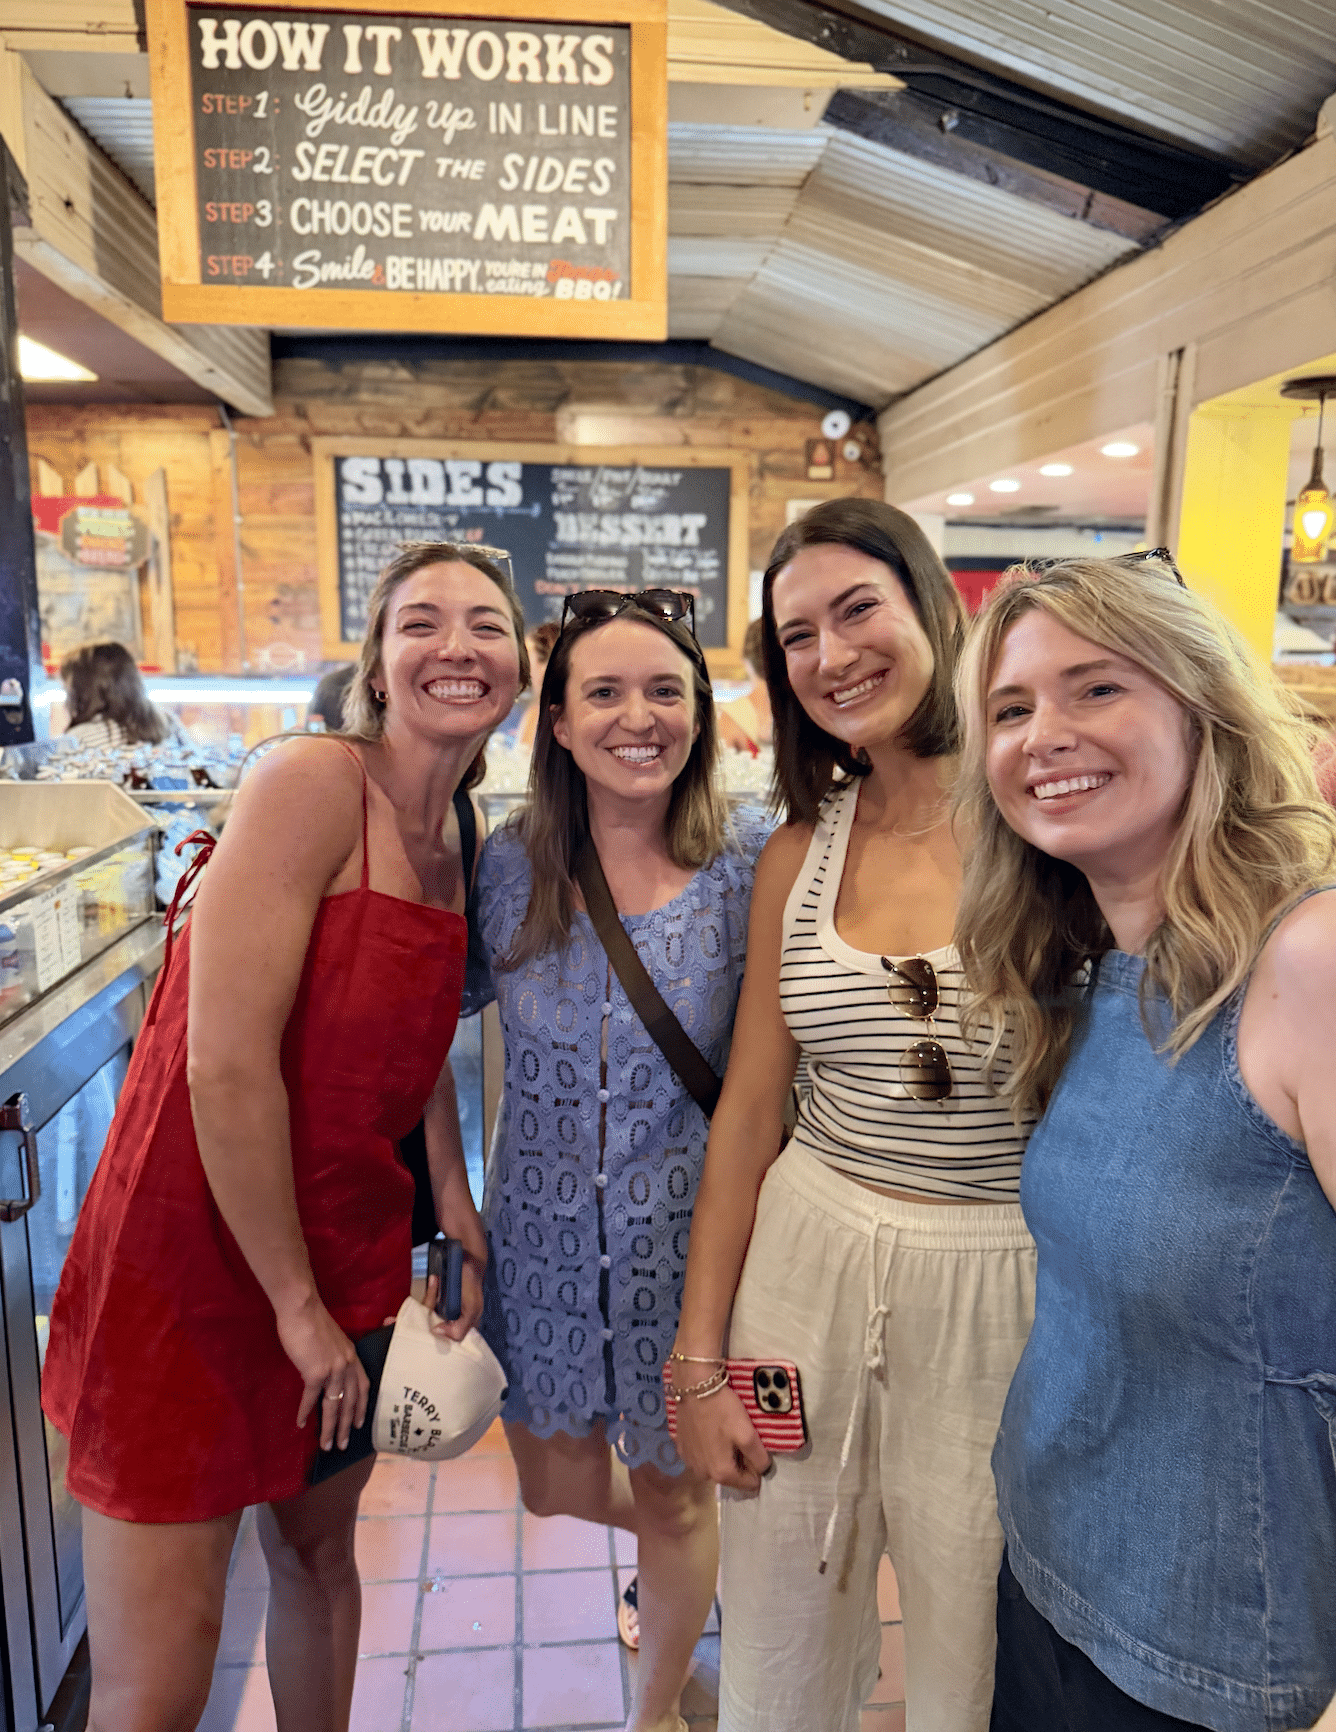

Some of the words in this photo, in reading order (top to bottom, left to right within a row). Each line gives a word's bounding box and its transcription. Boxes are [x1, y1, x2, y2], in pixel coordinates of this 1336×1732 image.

[198, 18, 330, 71] HOW
[343, 24, 402, 75] IT
[411, 27, 614, 86] WORKS
[294, 83, 418, 146] Giddy
[489, 101, 522, 135] IN
[538, 103, 618, 138] LINE
[291, 141, 425, 186] SELECT
[435, 157, 487, 180] THE
[499, 152, 616, 196] SIDES
[290, 197, 413, 238] CHOOSE
[418, 209, 473, 234] YOUR
[473, 203, 618, 245] MEAT
[292, 244, 375, 290] Smile
[371, 263, 387, 285] &
[531, 262, 548, 278] IN
[341, 457, 523, 507] SIDES
[553, 511, 707, 546] DESSERT
[404, 1386, 441, 1422] TERRY
